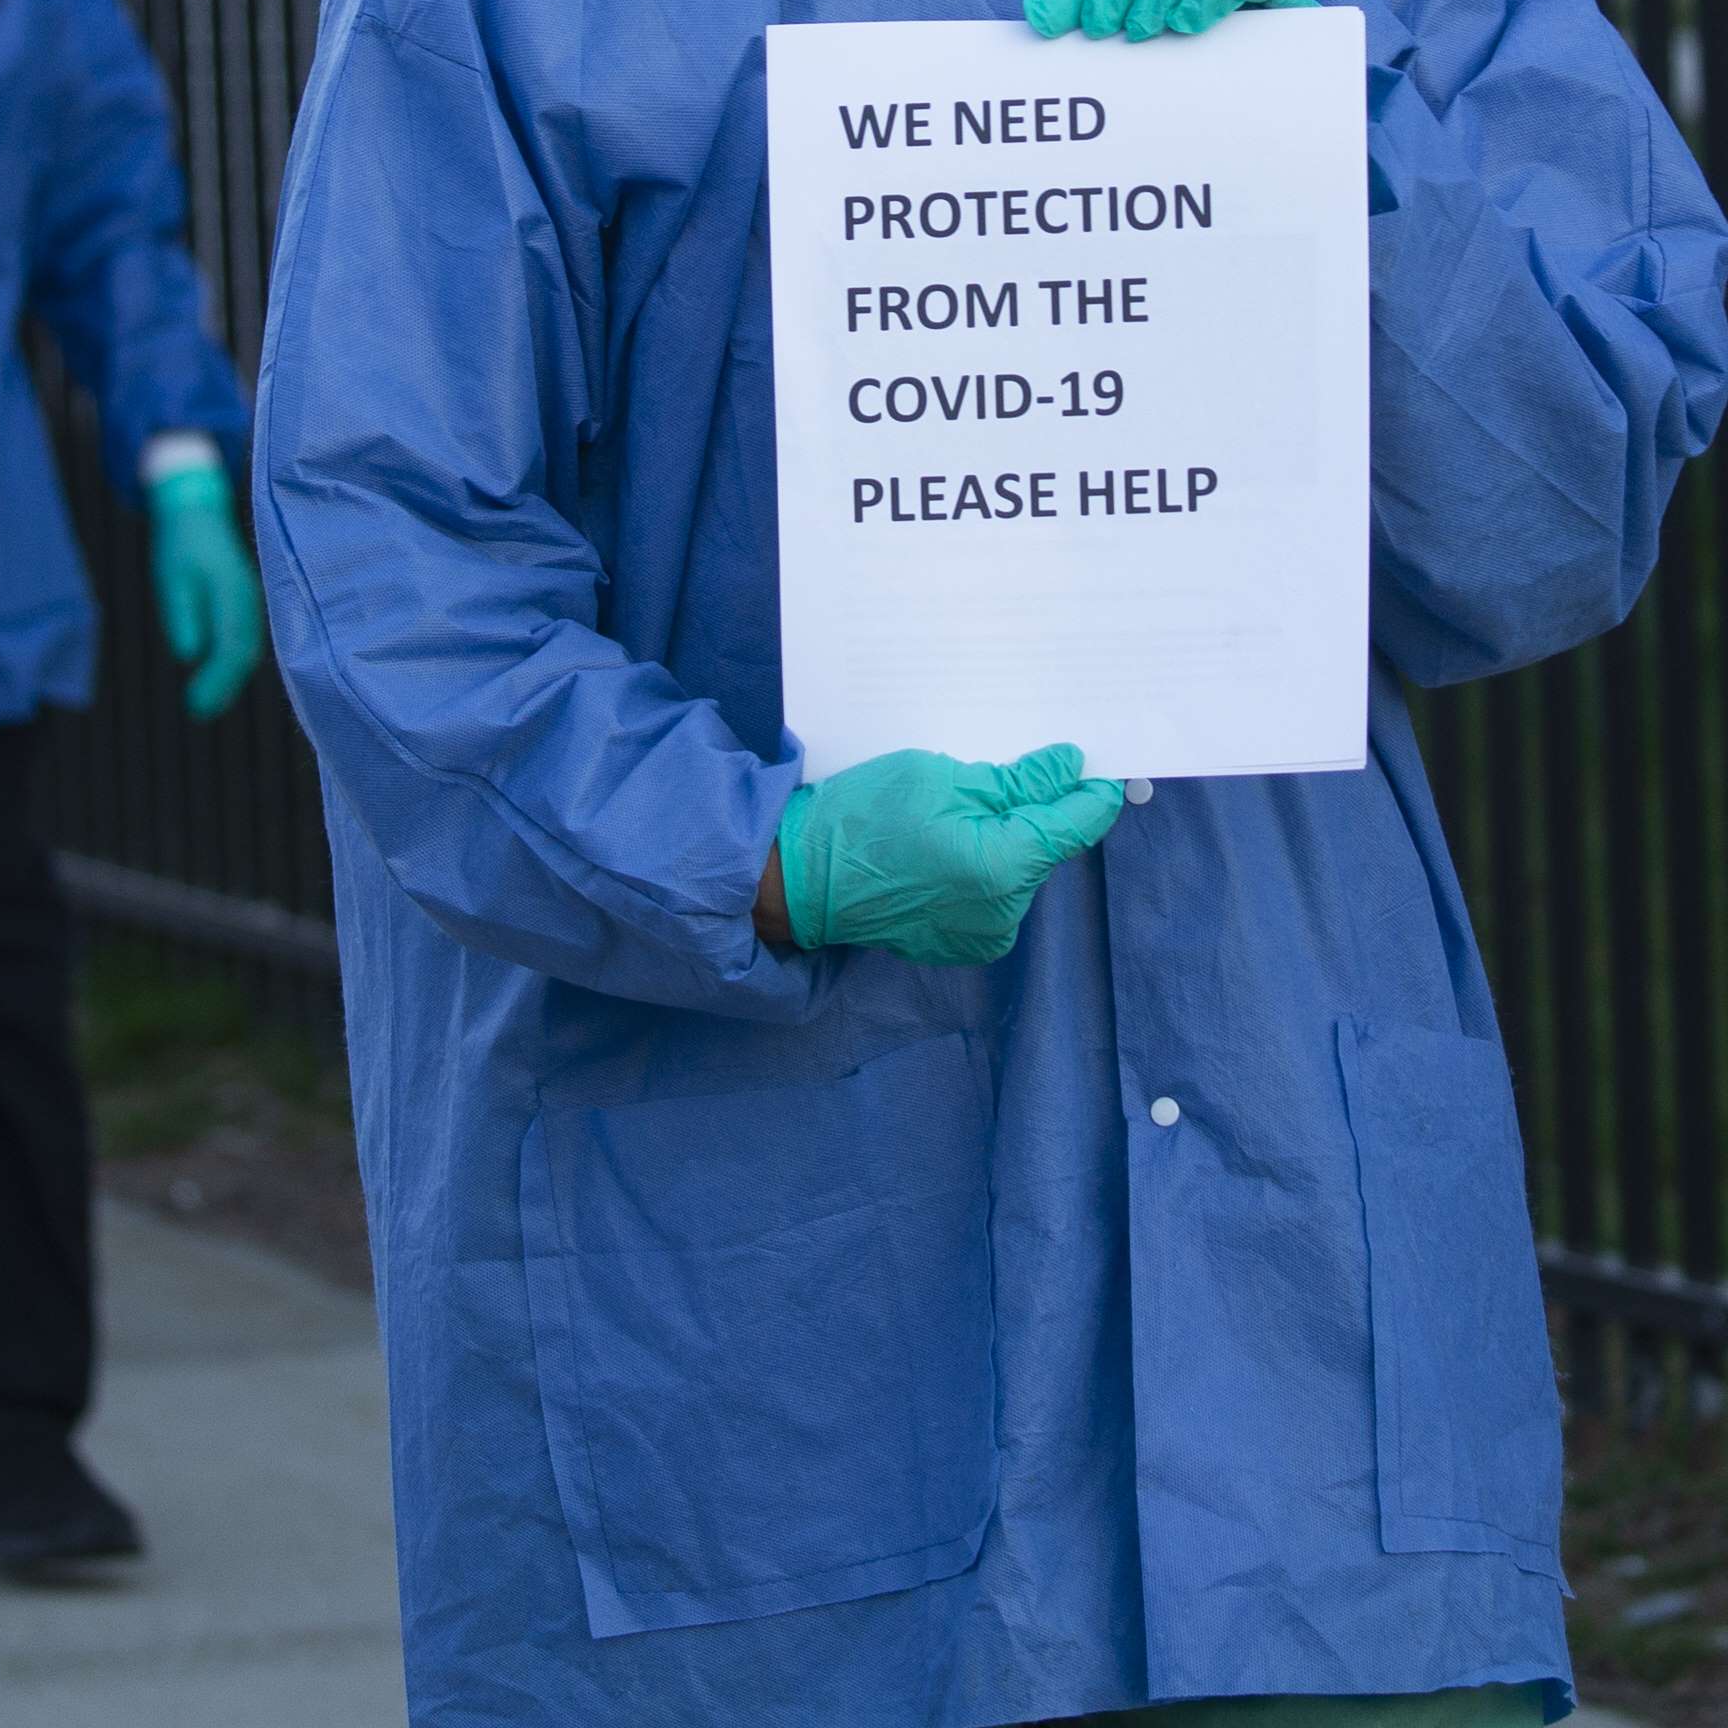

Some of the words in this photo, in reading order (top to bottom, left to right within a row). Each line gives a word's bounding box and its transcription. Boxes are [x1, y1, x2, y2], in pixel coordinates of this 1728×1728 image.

[839, 102, 932, 150] WE
[954, 96, 1106, 146] NEED
[844, 183, 1212, 241] PROTECTION
[846, 282, 1019, 333] FROM
[1038, 277, 1149, 326] THE
[848, 369, 1125, 424] COVID-19
[853, 472, 1058, 524] PLEASE
[1079, 467, 1218, 517] HELP
